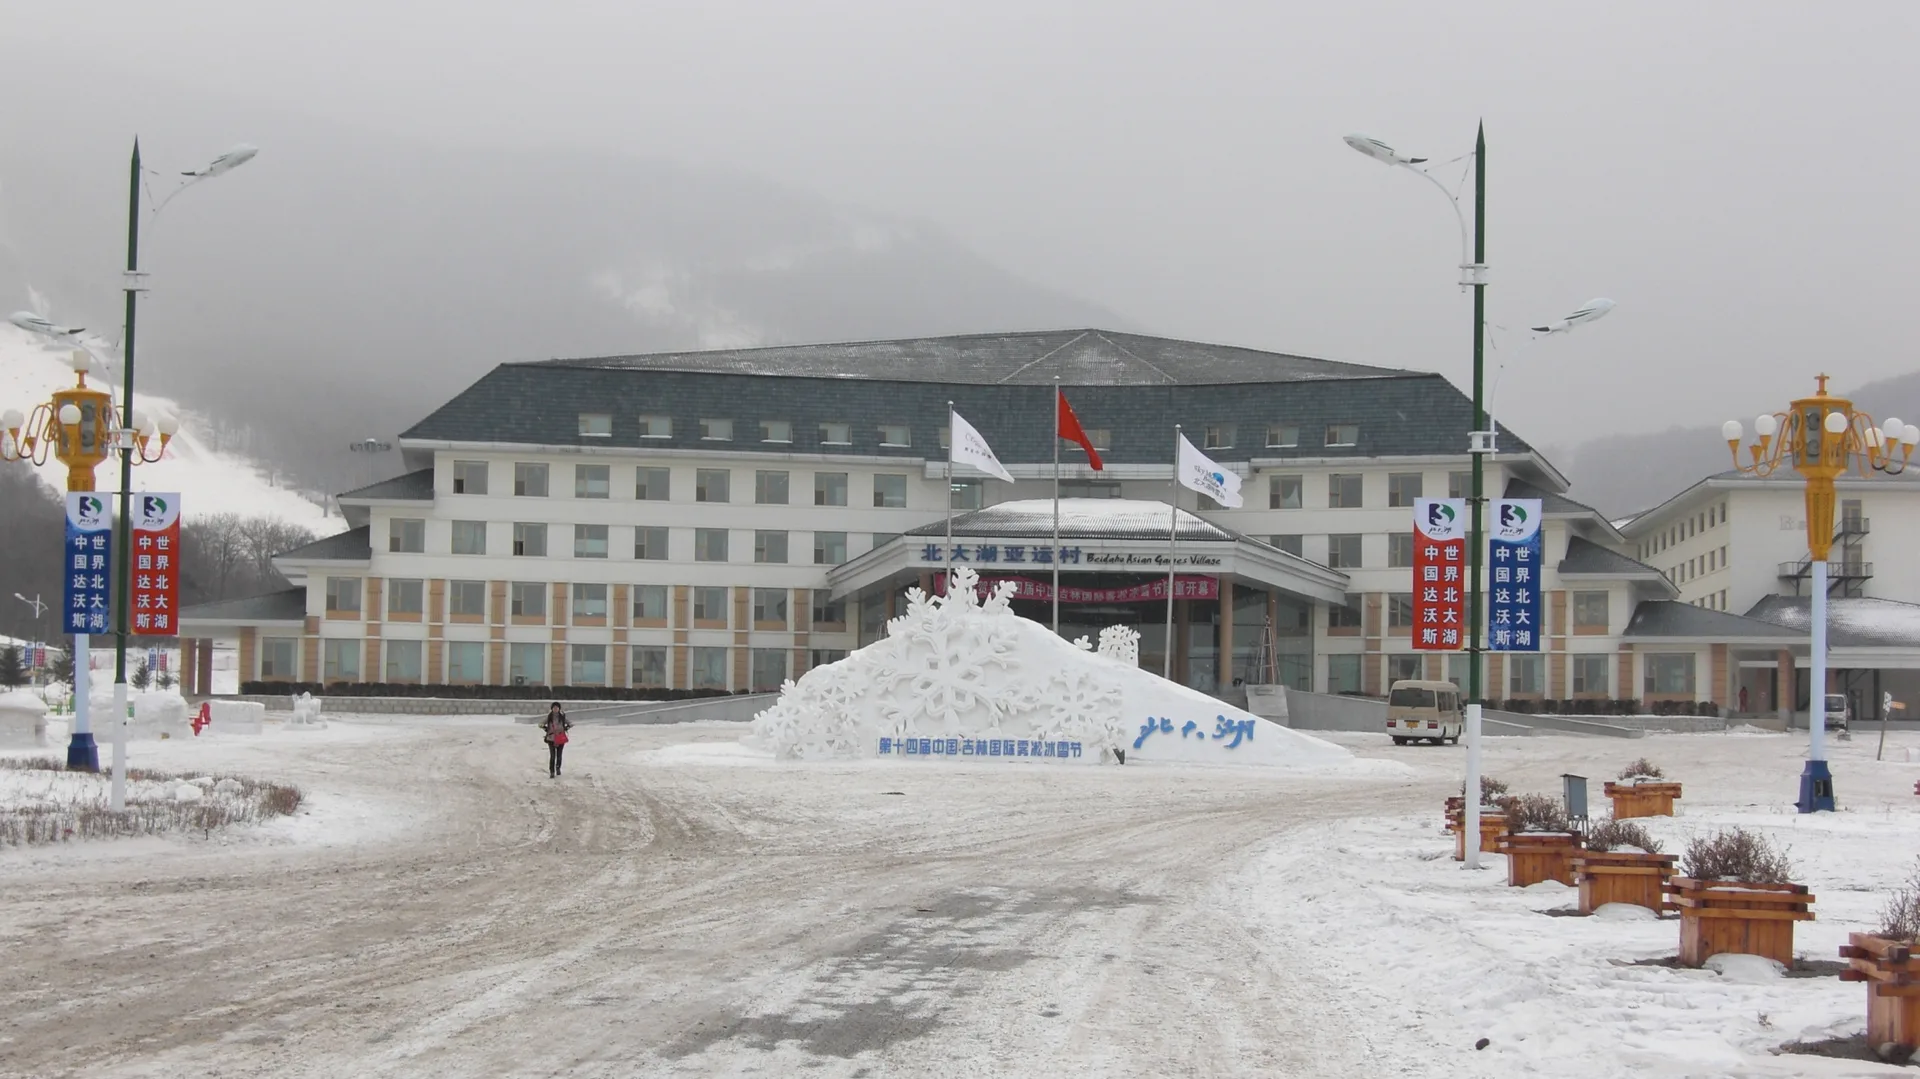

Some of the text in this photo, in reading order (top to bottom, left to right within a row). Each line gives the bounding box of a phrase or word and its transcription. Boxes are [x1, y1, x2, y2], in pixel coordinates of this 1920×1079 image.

[72, 535, 87, 629] 中国达沃斯
[90, 536, 106, 629] 世界北大湖
[136, 535, 152, 629] 中国达沃斯
[154, 536, 170, 629] 世界北大湖
[921, 544, 1082, 564] 北大湖亚运村
[1086, 553, 1221, 566] Beidahu Asian Games Village
[1422, 545, 1439, 645] 中国达沃斯
[1442, 545, 1459, 645] 世界北大湖
[1495, 546, 1511, 646] 中国达沃斯
[1515, 547, 1531, 647] 世界北大湖
